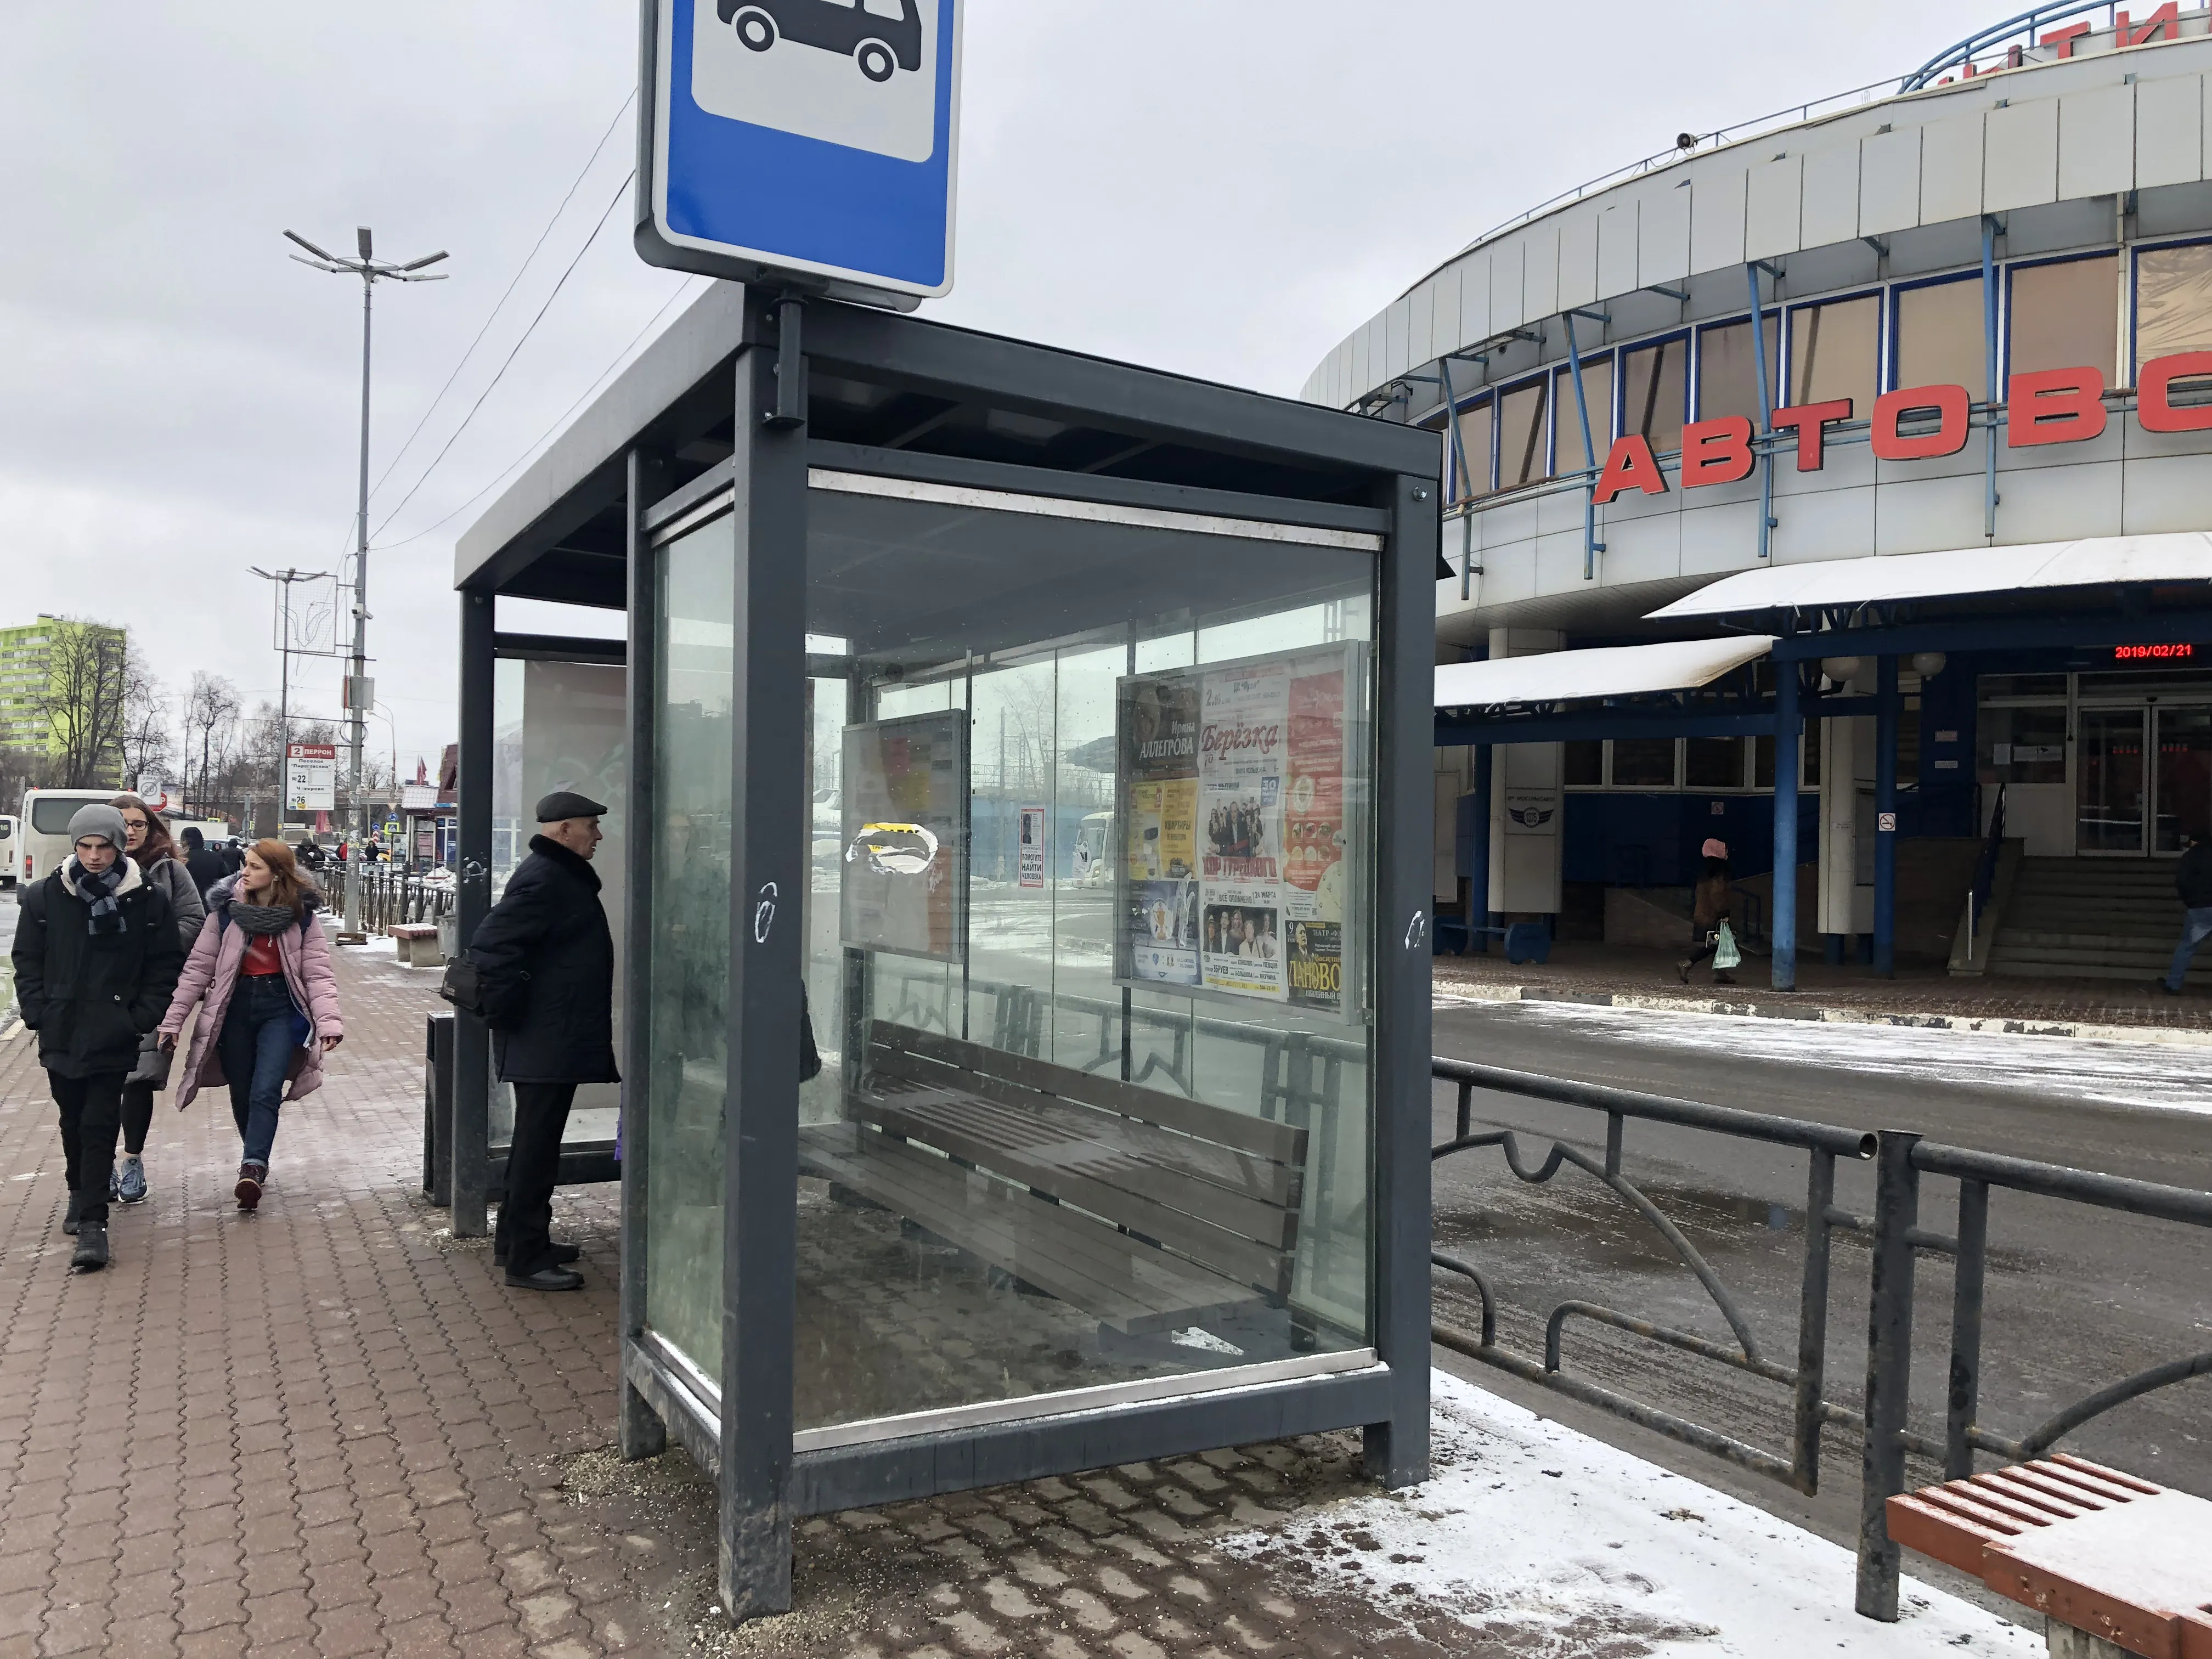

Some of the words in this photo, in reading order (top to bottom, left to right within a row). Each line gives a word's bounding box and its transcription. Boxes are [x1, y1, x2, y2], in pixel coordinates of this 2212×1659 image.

[2115, 644, 2191, 658] 2019/02/21
[1171, 720, 1195, 737] Ирина
[1201, 721, 1278, 760] Берёзка
[1139, 737, 1194, 761] АЛЛЕГРОВА
[297, 775, 306, 783] 22
[1262, 780, 1277, 791] 30
[1022, 853, 1042, 861] ПОМОГИТЕ
[1022, 861, 1041, 871] НАЙТИ
[1289, 922, 1294, 934] 9
[1214, 964, 1228, 974] ЗБРУЕВ
